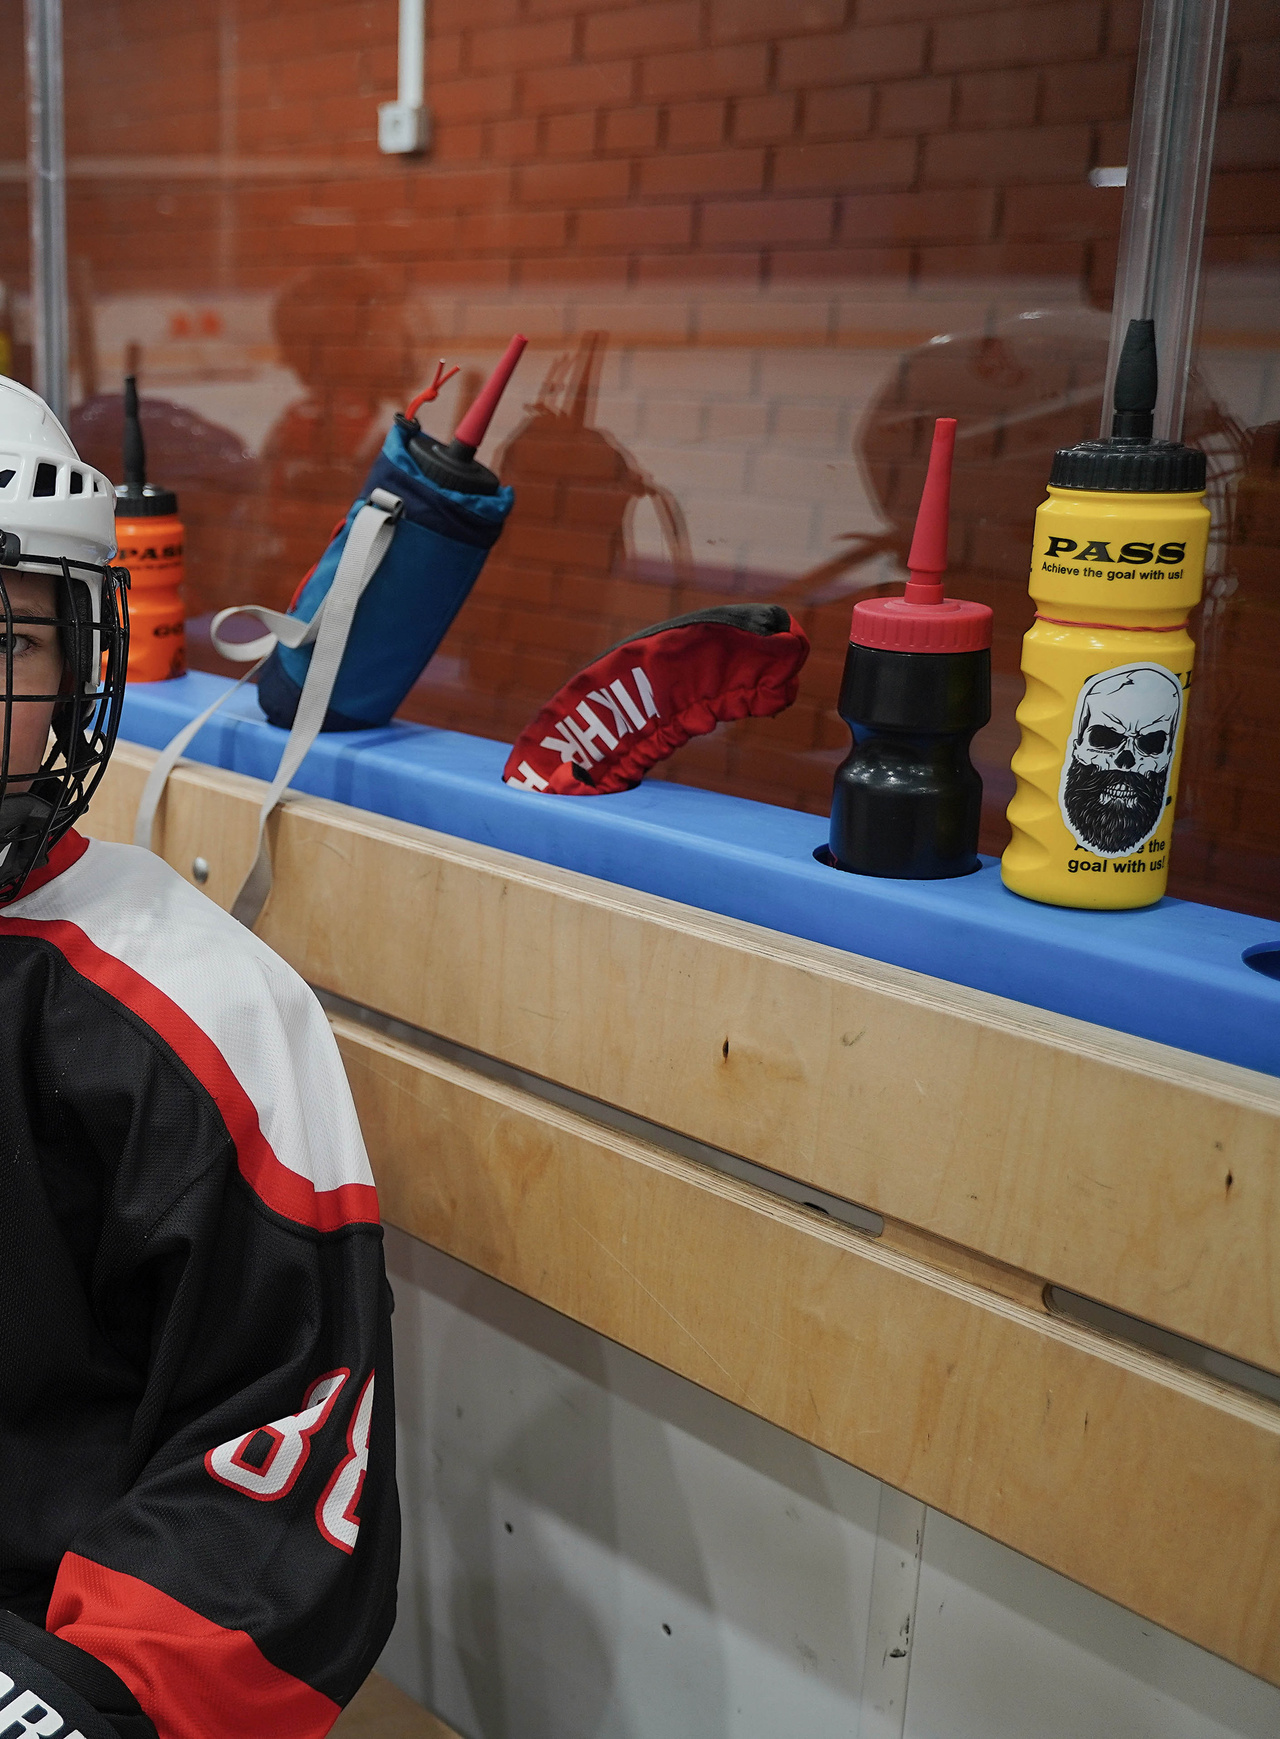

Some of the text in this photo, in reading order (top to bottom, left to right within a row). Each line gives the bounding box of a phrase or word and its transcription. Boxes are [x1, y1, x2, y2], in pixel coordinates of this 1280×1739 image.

[119, 544, 183, 560] PAS
[1043, 535, 1187, 565] PASS
[1041, 561, 1184, 581] Achieve the goal with us!
[1148, 839, 1165, 853] the
[1067, 856, 1165, 874] goal with us!
